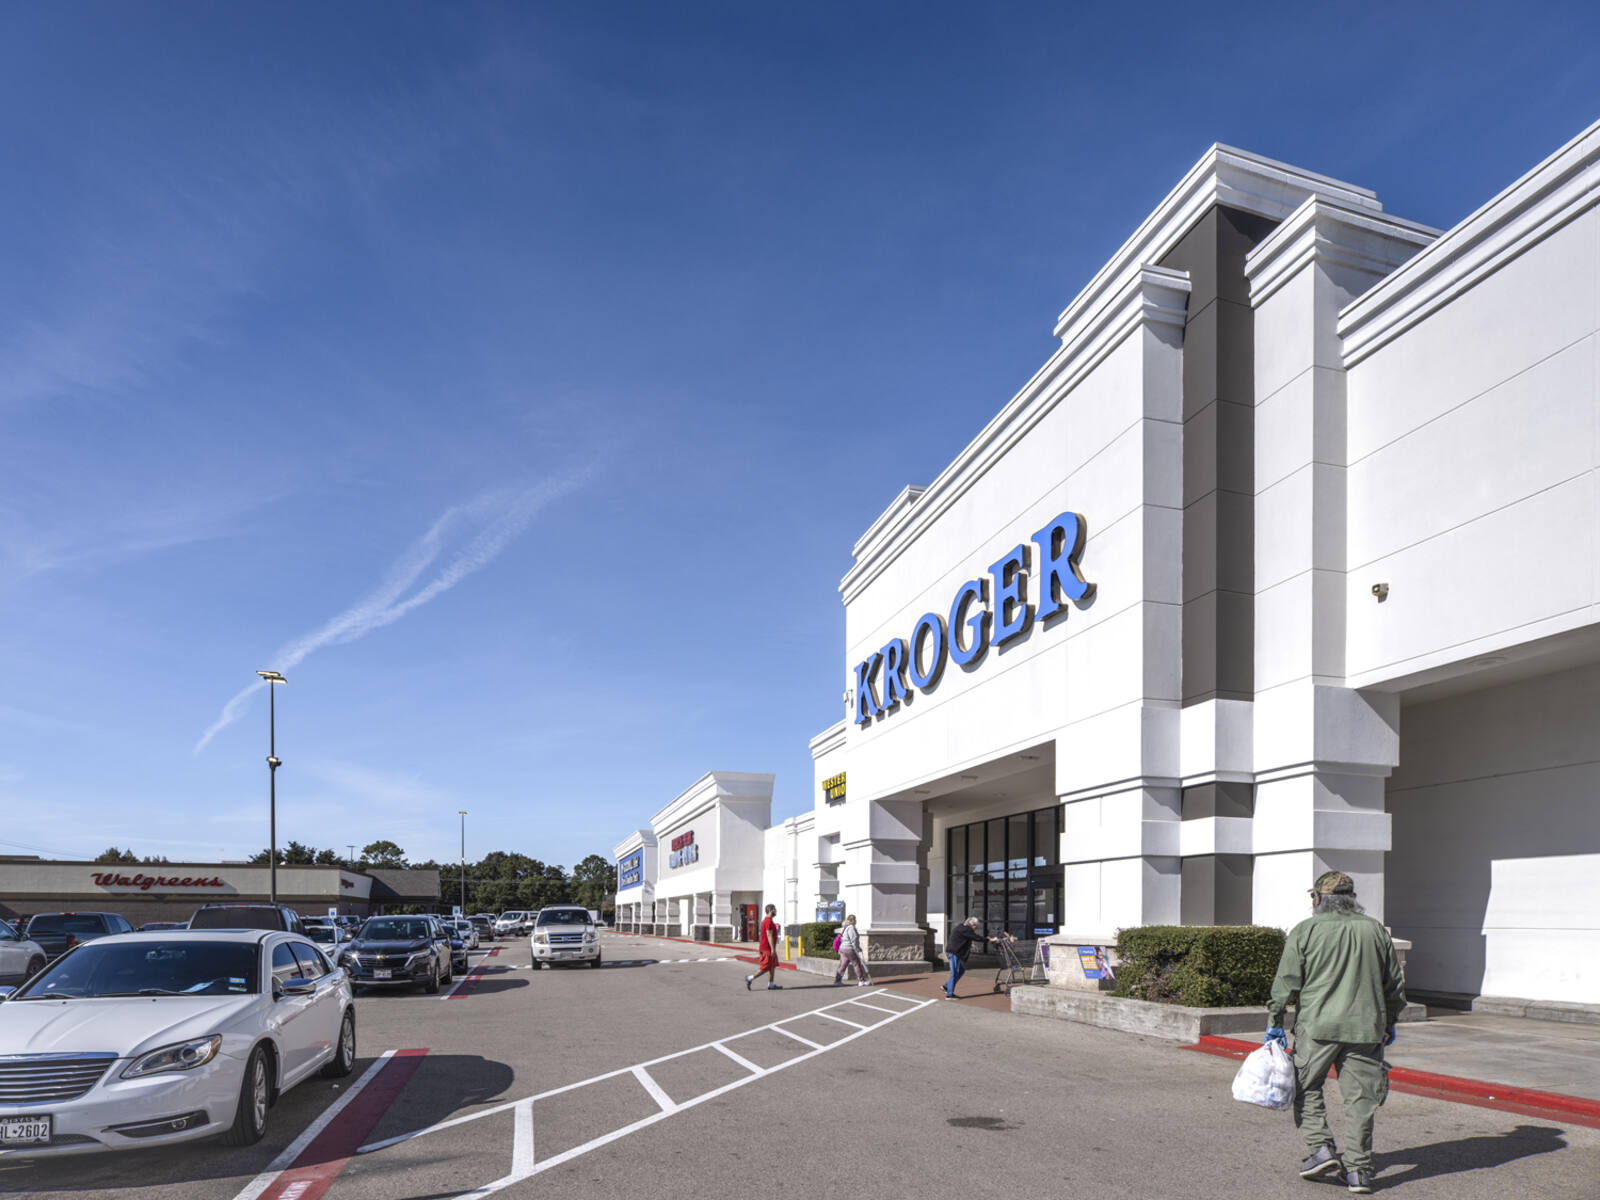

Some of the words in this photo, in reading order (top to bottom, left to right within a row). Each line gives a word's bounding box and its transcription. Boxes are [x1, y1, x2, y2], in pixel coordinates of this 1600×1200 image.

[854, 511, 1096, 727] KROGER
[822, 771, 846, 790] WESTER
[830, 783, 846, 799] UNIO
[91, 873, 224, 891] Walgreens
